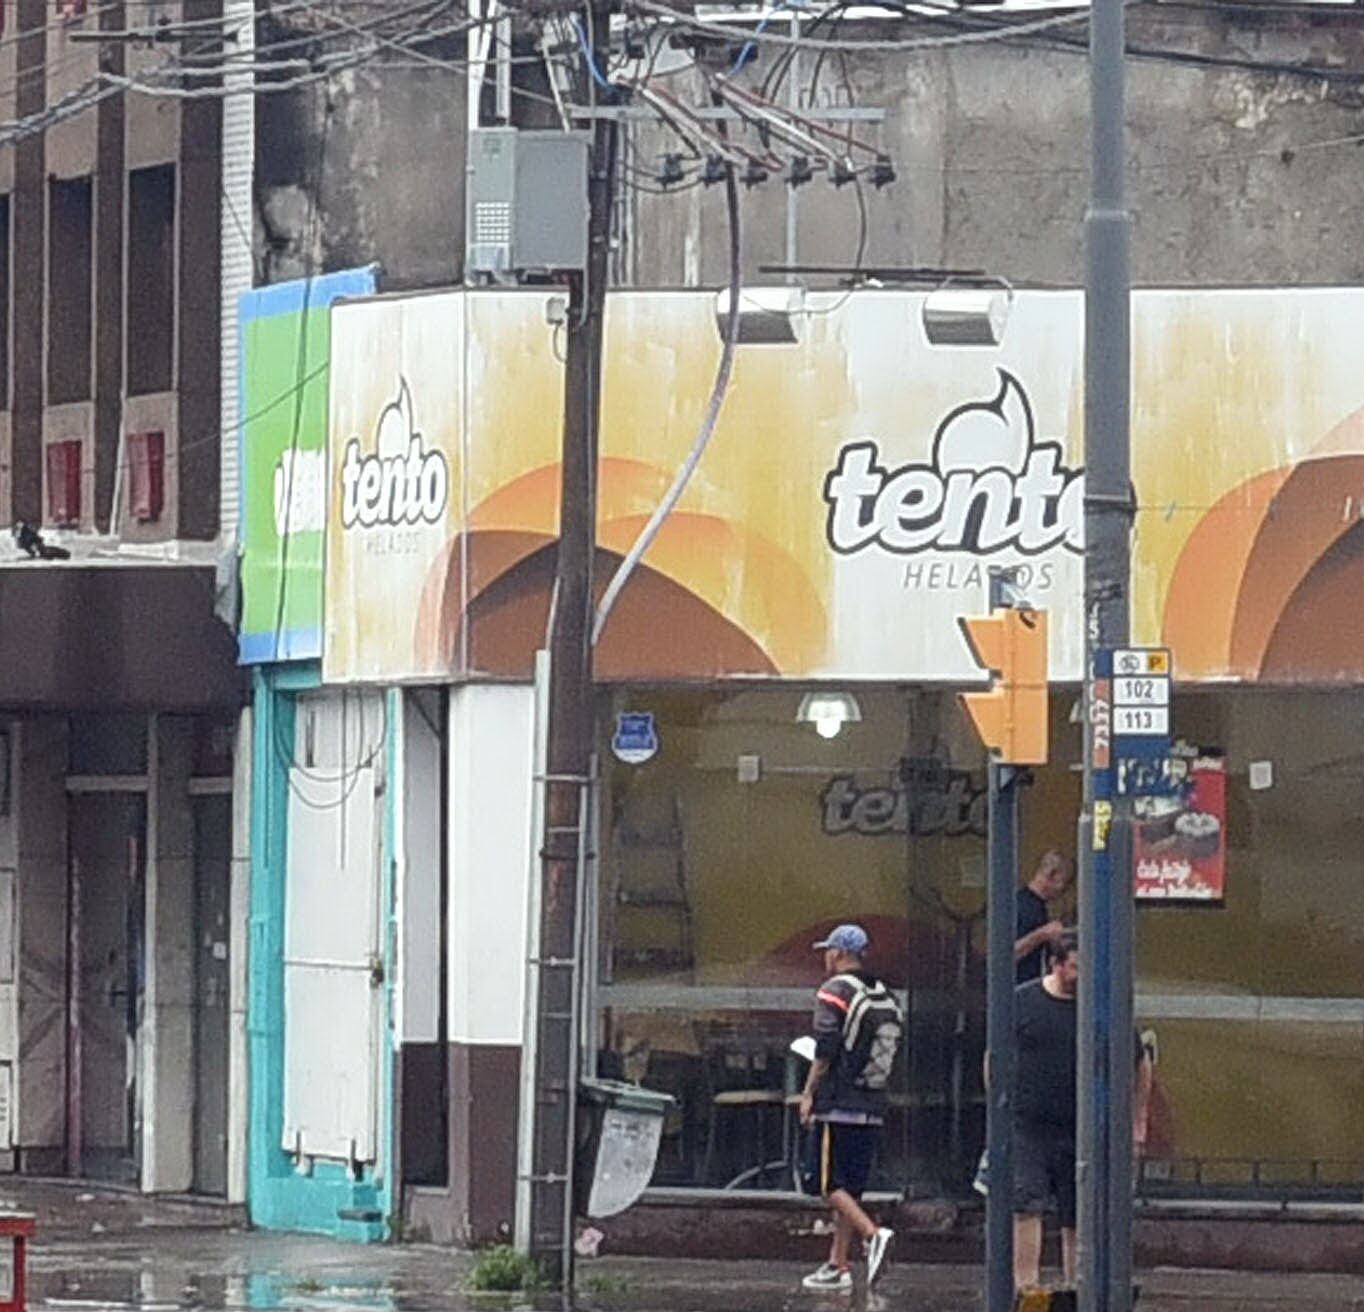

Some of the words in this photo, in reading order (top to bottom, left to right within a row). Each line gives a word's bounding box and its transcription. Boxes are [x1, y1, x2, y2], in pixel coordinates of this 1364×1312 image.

[341, 433, 449, 528] tento
[904, 563, 1053, 590] HELAOS
[1125, 680, 1154, 698] 102
[1125, 711, 1153, 729] 113
